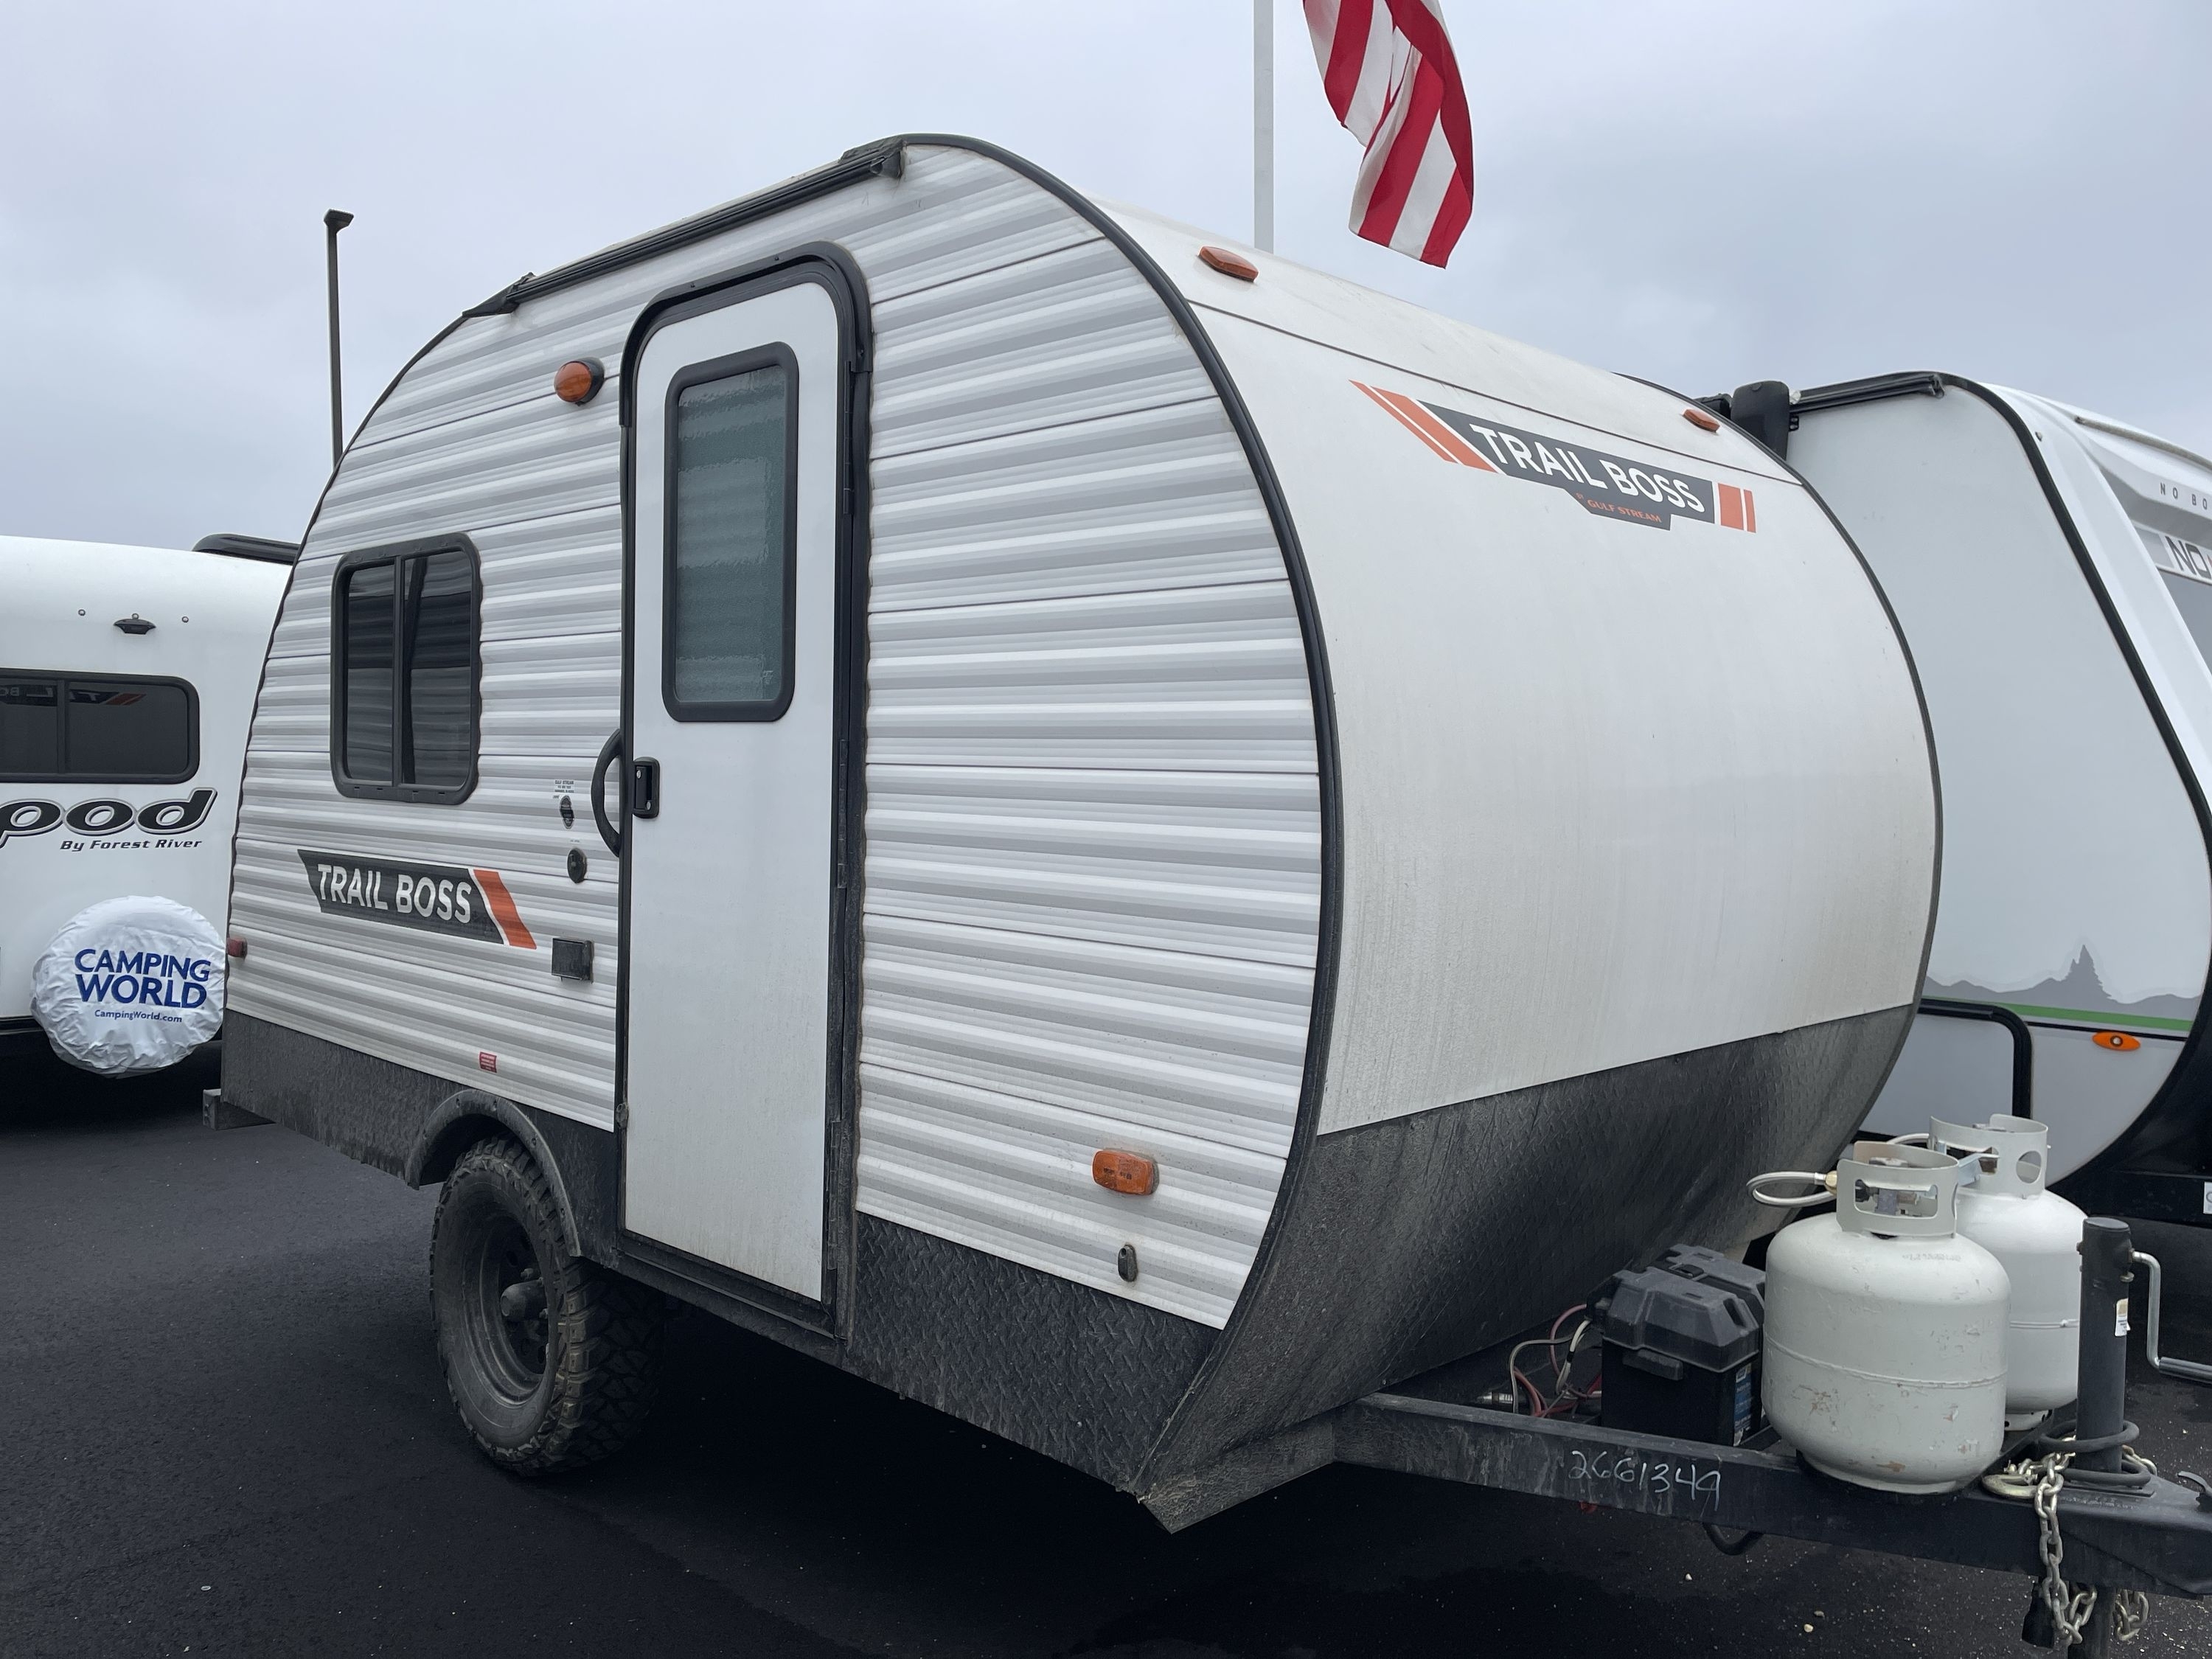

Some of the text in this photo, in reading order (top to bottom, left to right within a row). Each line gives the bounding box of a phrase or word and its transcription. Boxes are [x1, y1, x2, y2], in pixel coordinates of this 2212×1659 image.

[1469, 423, 1705, 514] TRAIL BOSS
[2160, 482, 2178, 499] NO
[1587, 499, 1662, 523] GULF STREAM
[60, 839, 203, 852] By Forest River
[317, 863, 472, 923] TRAIL BOSS
[74, 948, 211, 982] CAMPING
[75, 973, 207, 1009] WORLD
[94, 1009, 182, 1023] CampingWorld.com
